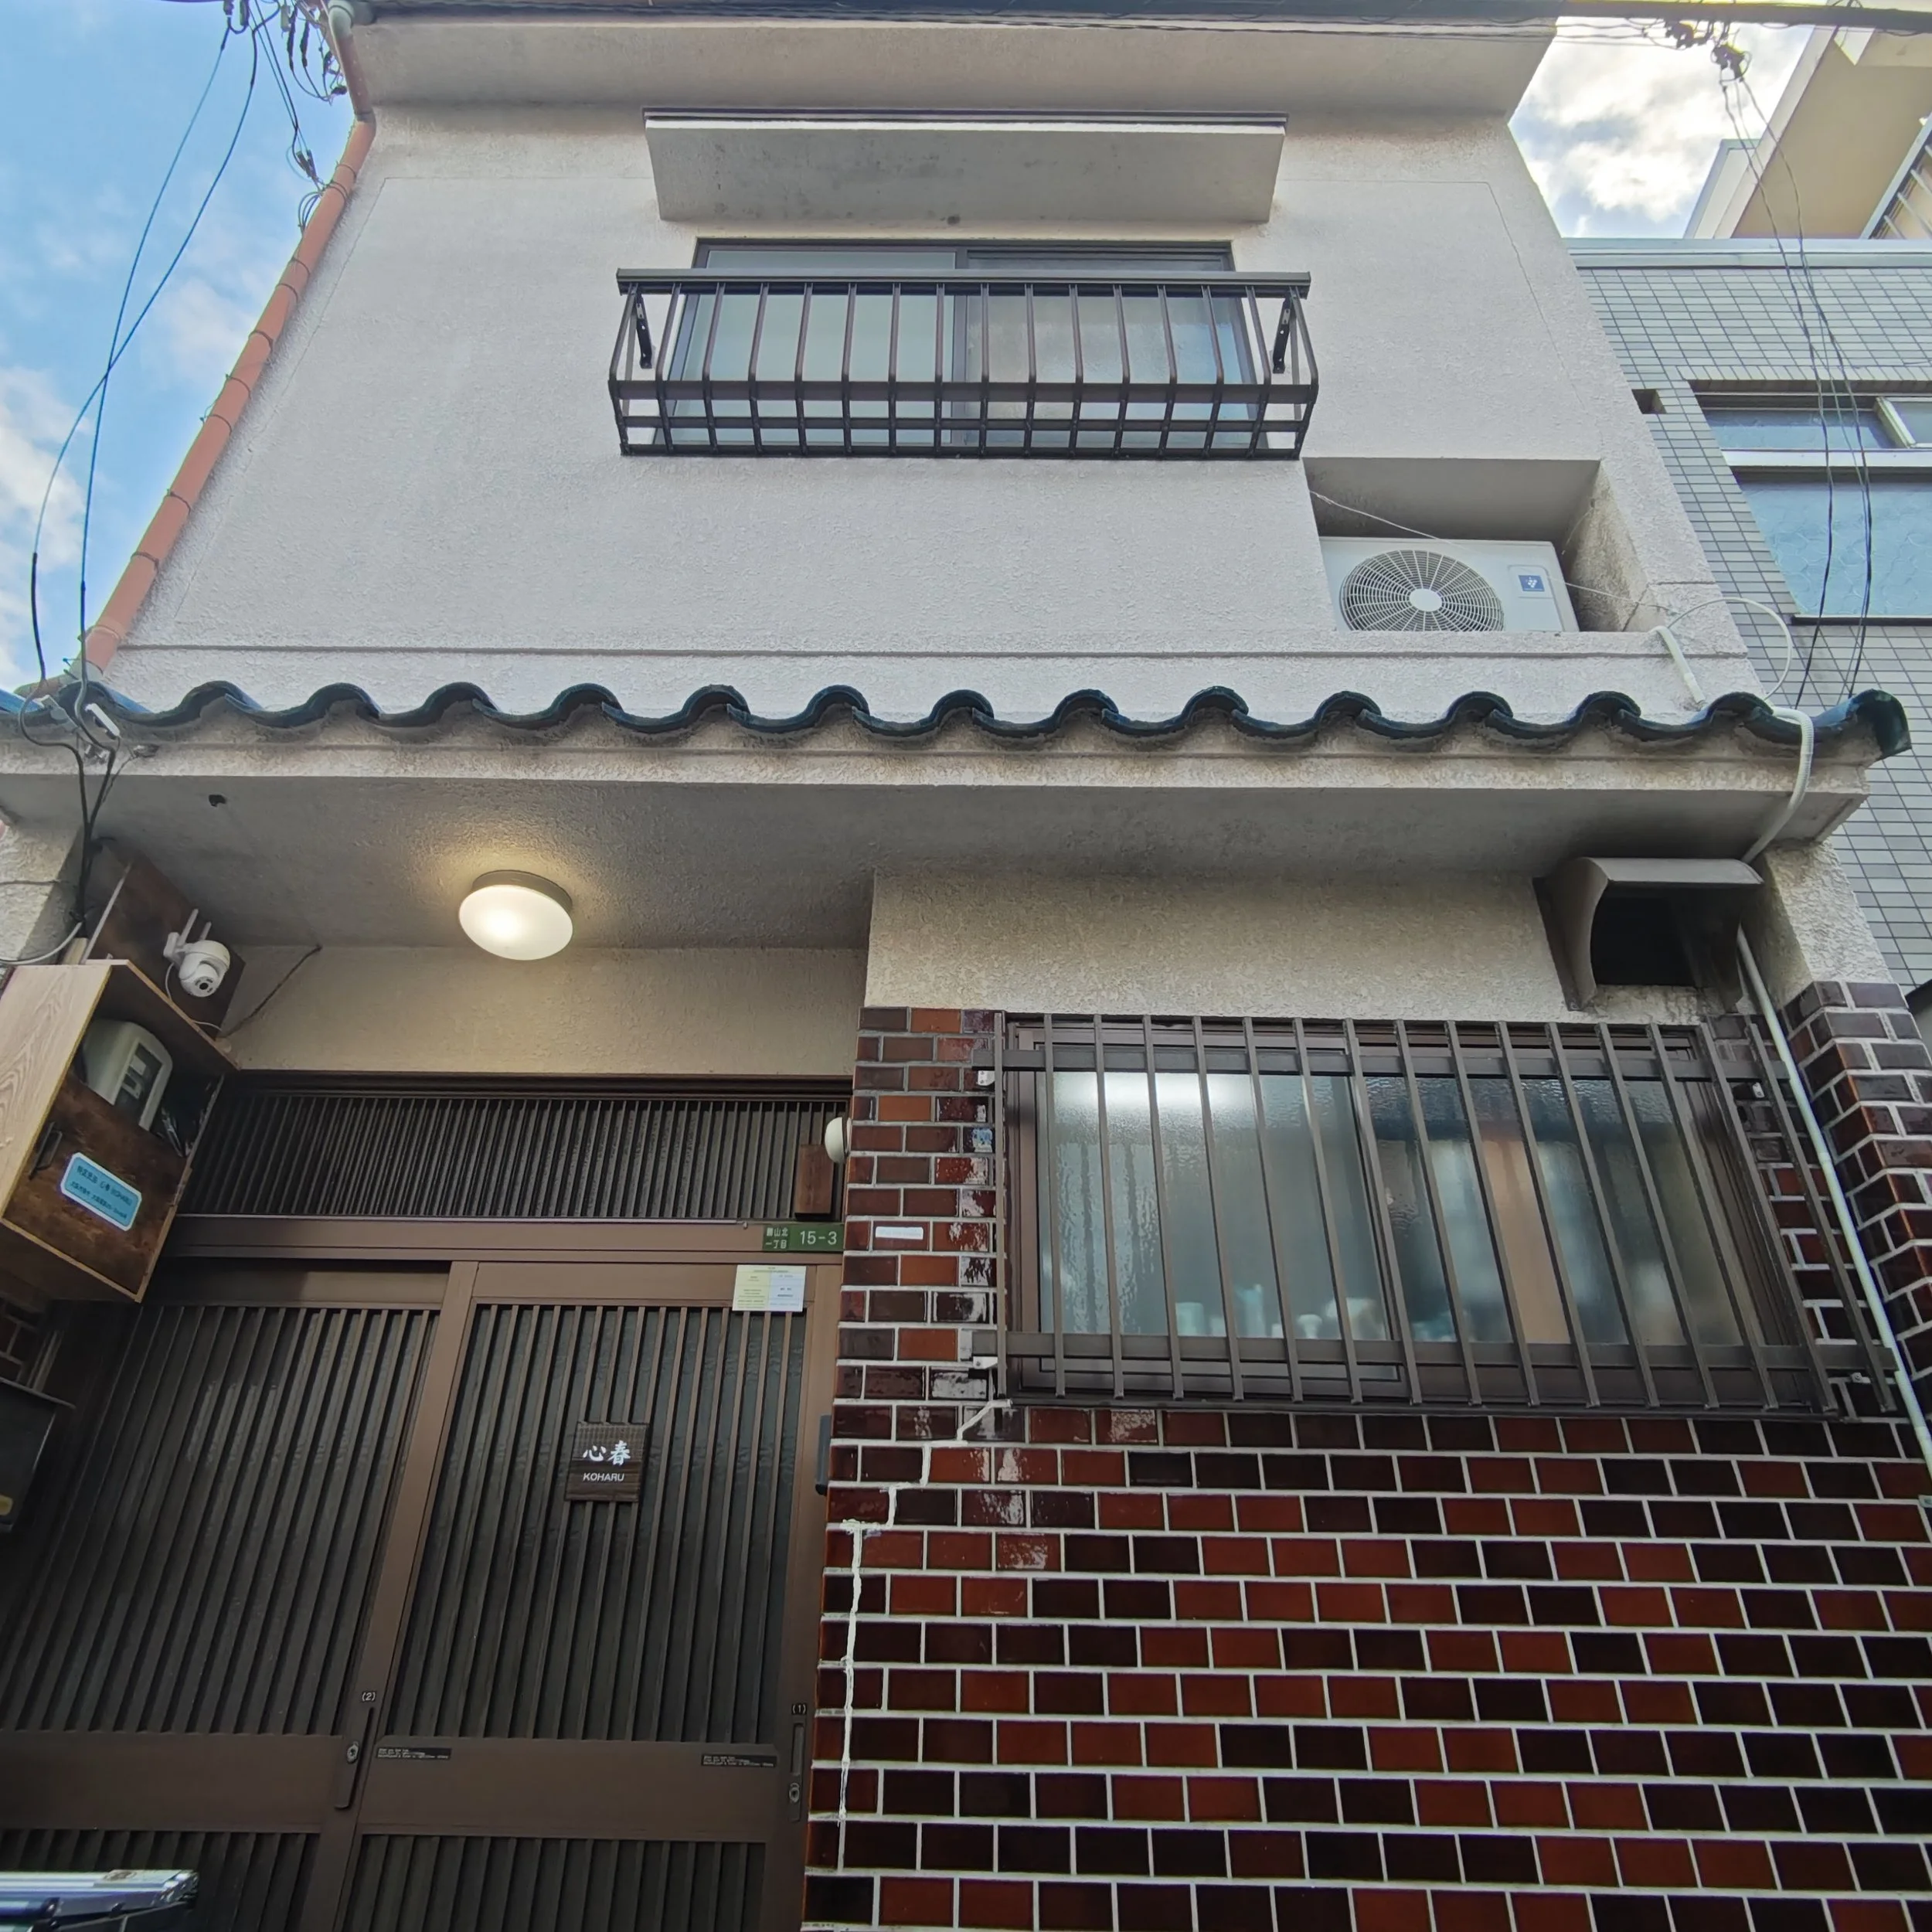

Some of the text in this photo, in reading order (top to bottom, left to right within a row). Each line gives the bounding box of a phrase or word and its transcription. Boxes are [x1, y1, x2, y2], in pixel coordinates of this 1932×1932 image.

[800, 1230, 837, 1245] 15-3
[765, 1240, 787, 1249] 一丁目
[582, 1440, 631, 1465] 心春
[583, 1472, 624, 1481] KOHARU
[362, 1692, 376, 1702] (2)
[792, 1704, 806, 1714] (1)
